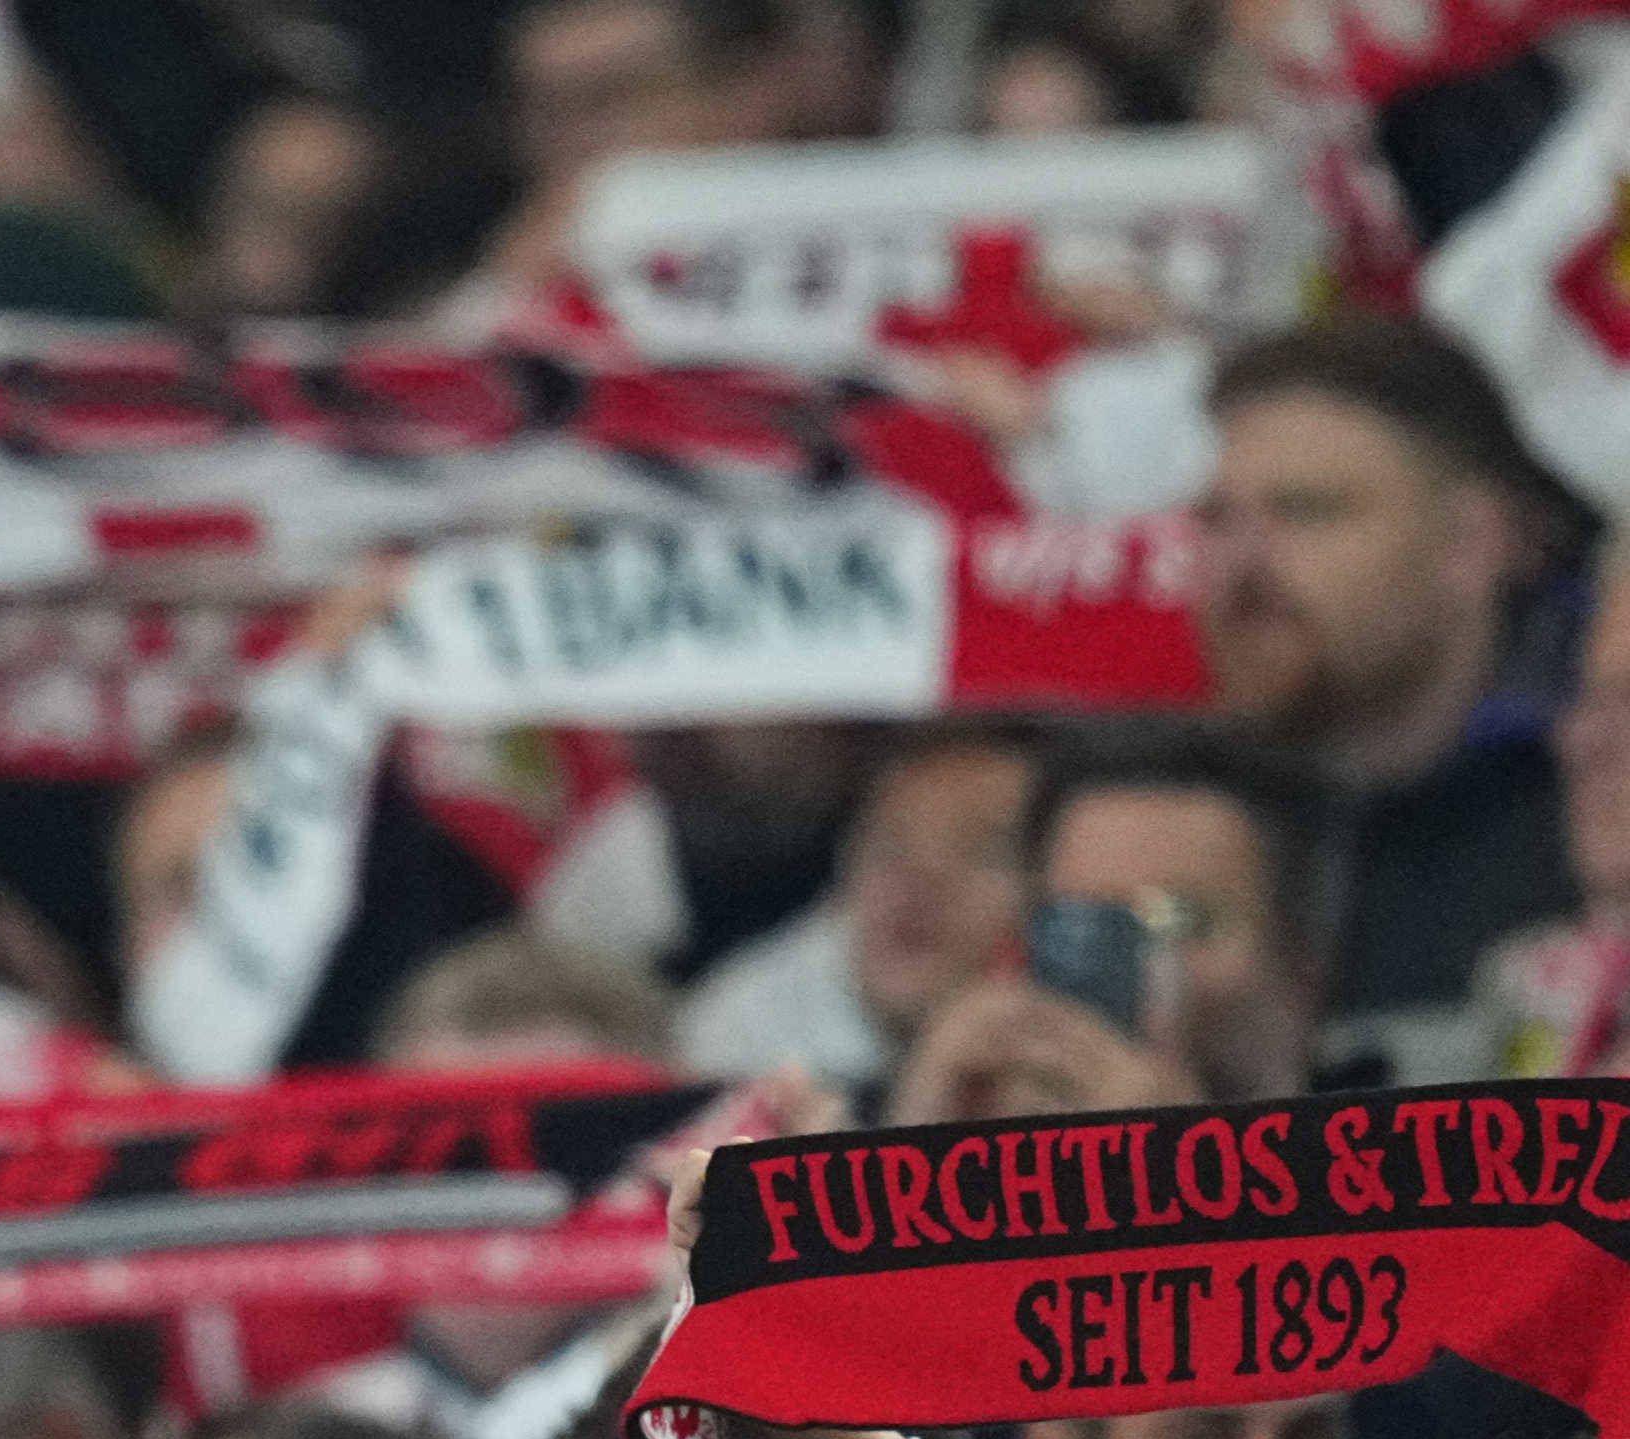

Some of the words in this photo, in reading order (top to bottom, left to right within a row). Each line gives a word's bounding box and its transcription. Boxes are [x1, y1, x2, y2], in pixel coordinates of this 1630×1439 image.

[751, 1112, 1298, 1262] FURCHTLOS
[1323, 1104, 1395, 1216] &
[1015, 1264, 1214, 1392] SEIT
[1234, 1255, 1408, 1377] 1893
